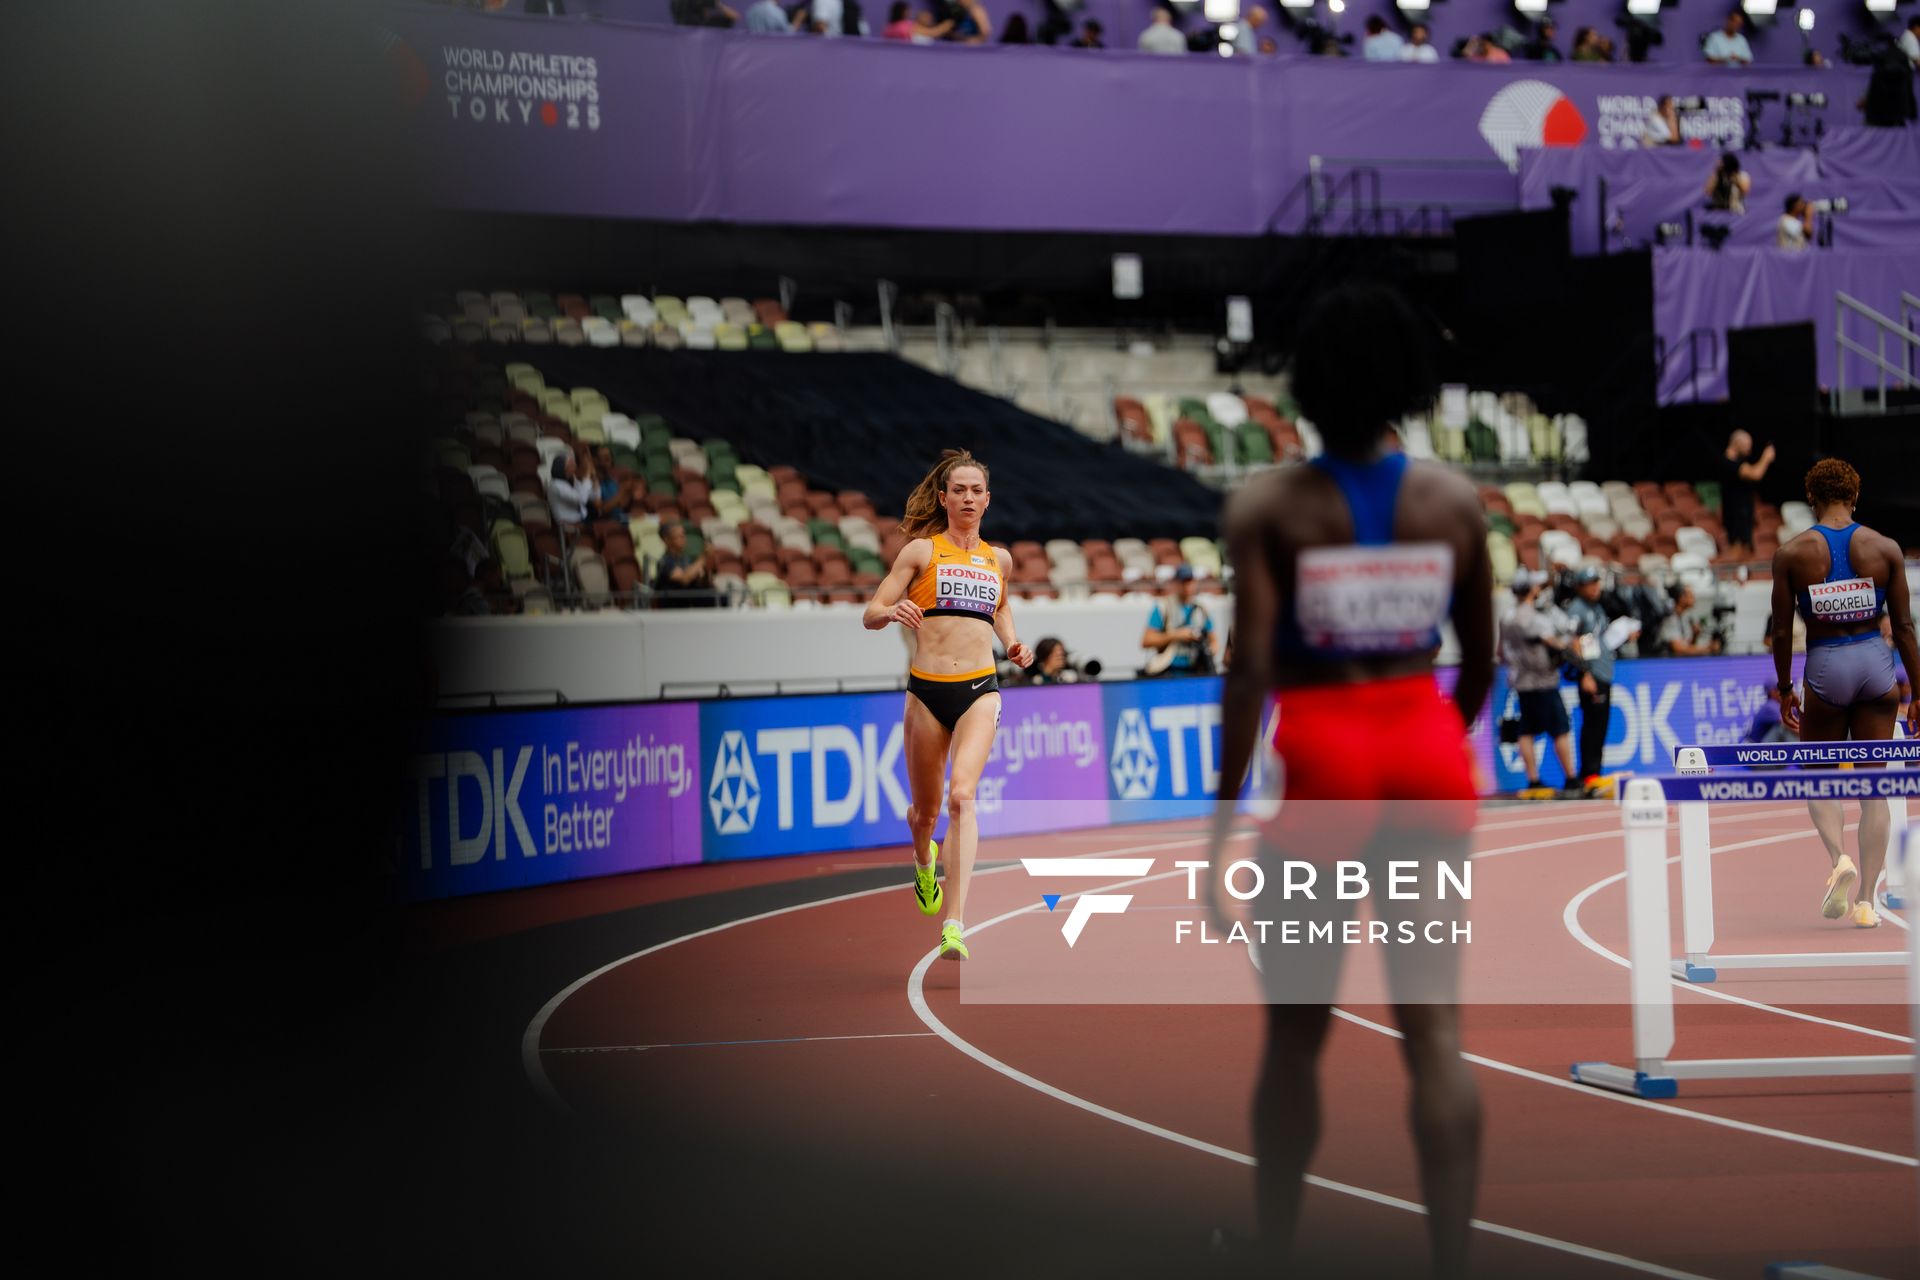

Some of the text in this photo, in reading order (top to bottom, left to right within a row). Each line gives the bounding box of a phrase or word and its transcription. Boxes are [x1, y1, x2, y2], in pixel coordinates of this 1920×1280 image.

[444, 48, 598, 79] WORLD ATHLETICS
[446, 70, 599, 103] CHAMPIONSHIPS
[939, 568, 998, 584] HONDA
[1812, 581, 1872, 595] HONDA
[941, 582, 996, 601] DEMES
[1815, 594, 1873, 612] COCKRELL
[543, 734, 692, 802] In Everything,
[1737, 750, 1788, 762] WORLD
[1792, 747, 1868, 761] ATHLETICS
[757, 723, 911, 830] TDK
[1699, 776, 1920, 799] WORLD ATHLETICS CHA
[405, 745, 537, 870] TDK
[544, 802, 614, 854] Better
